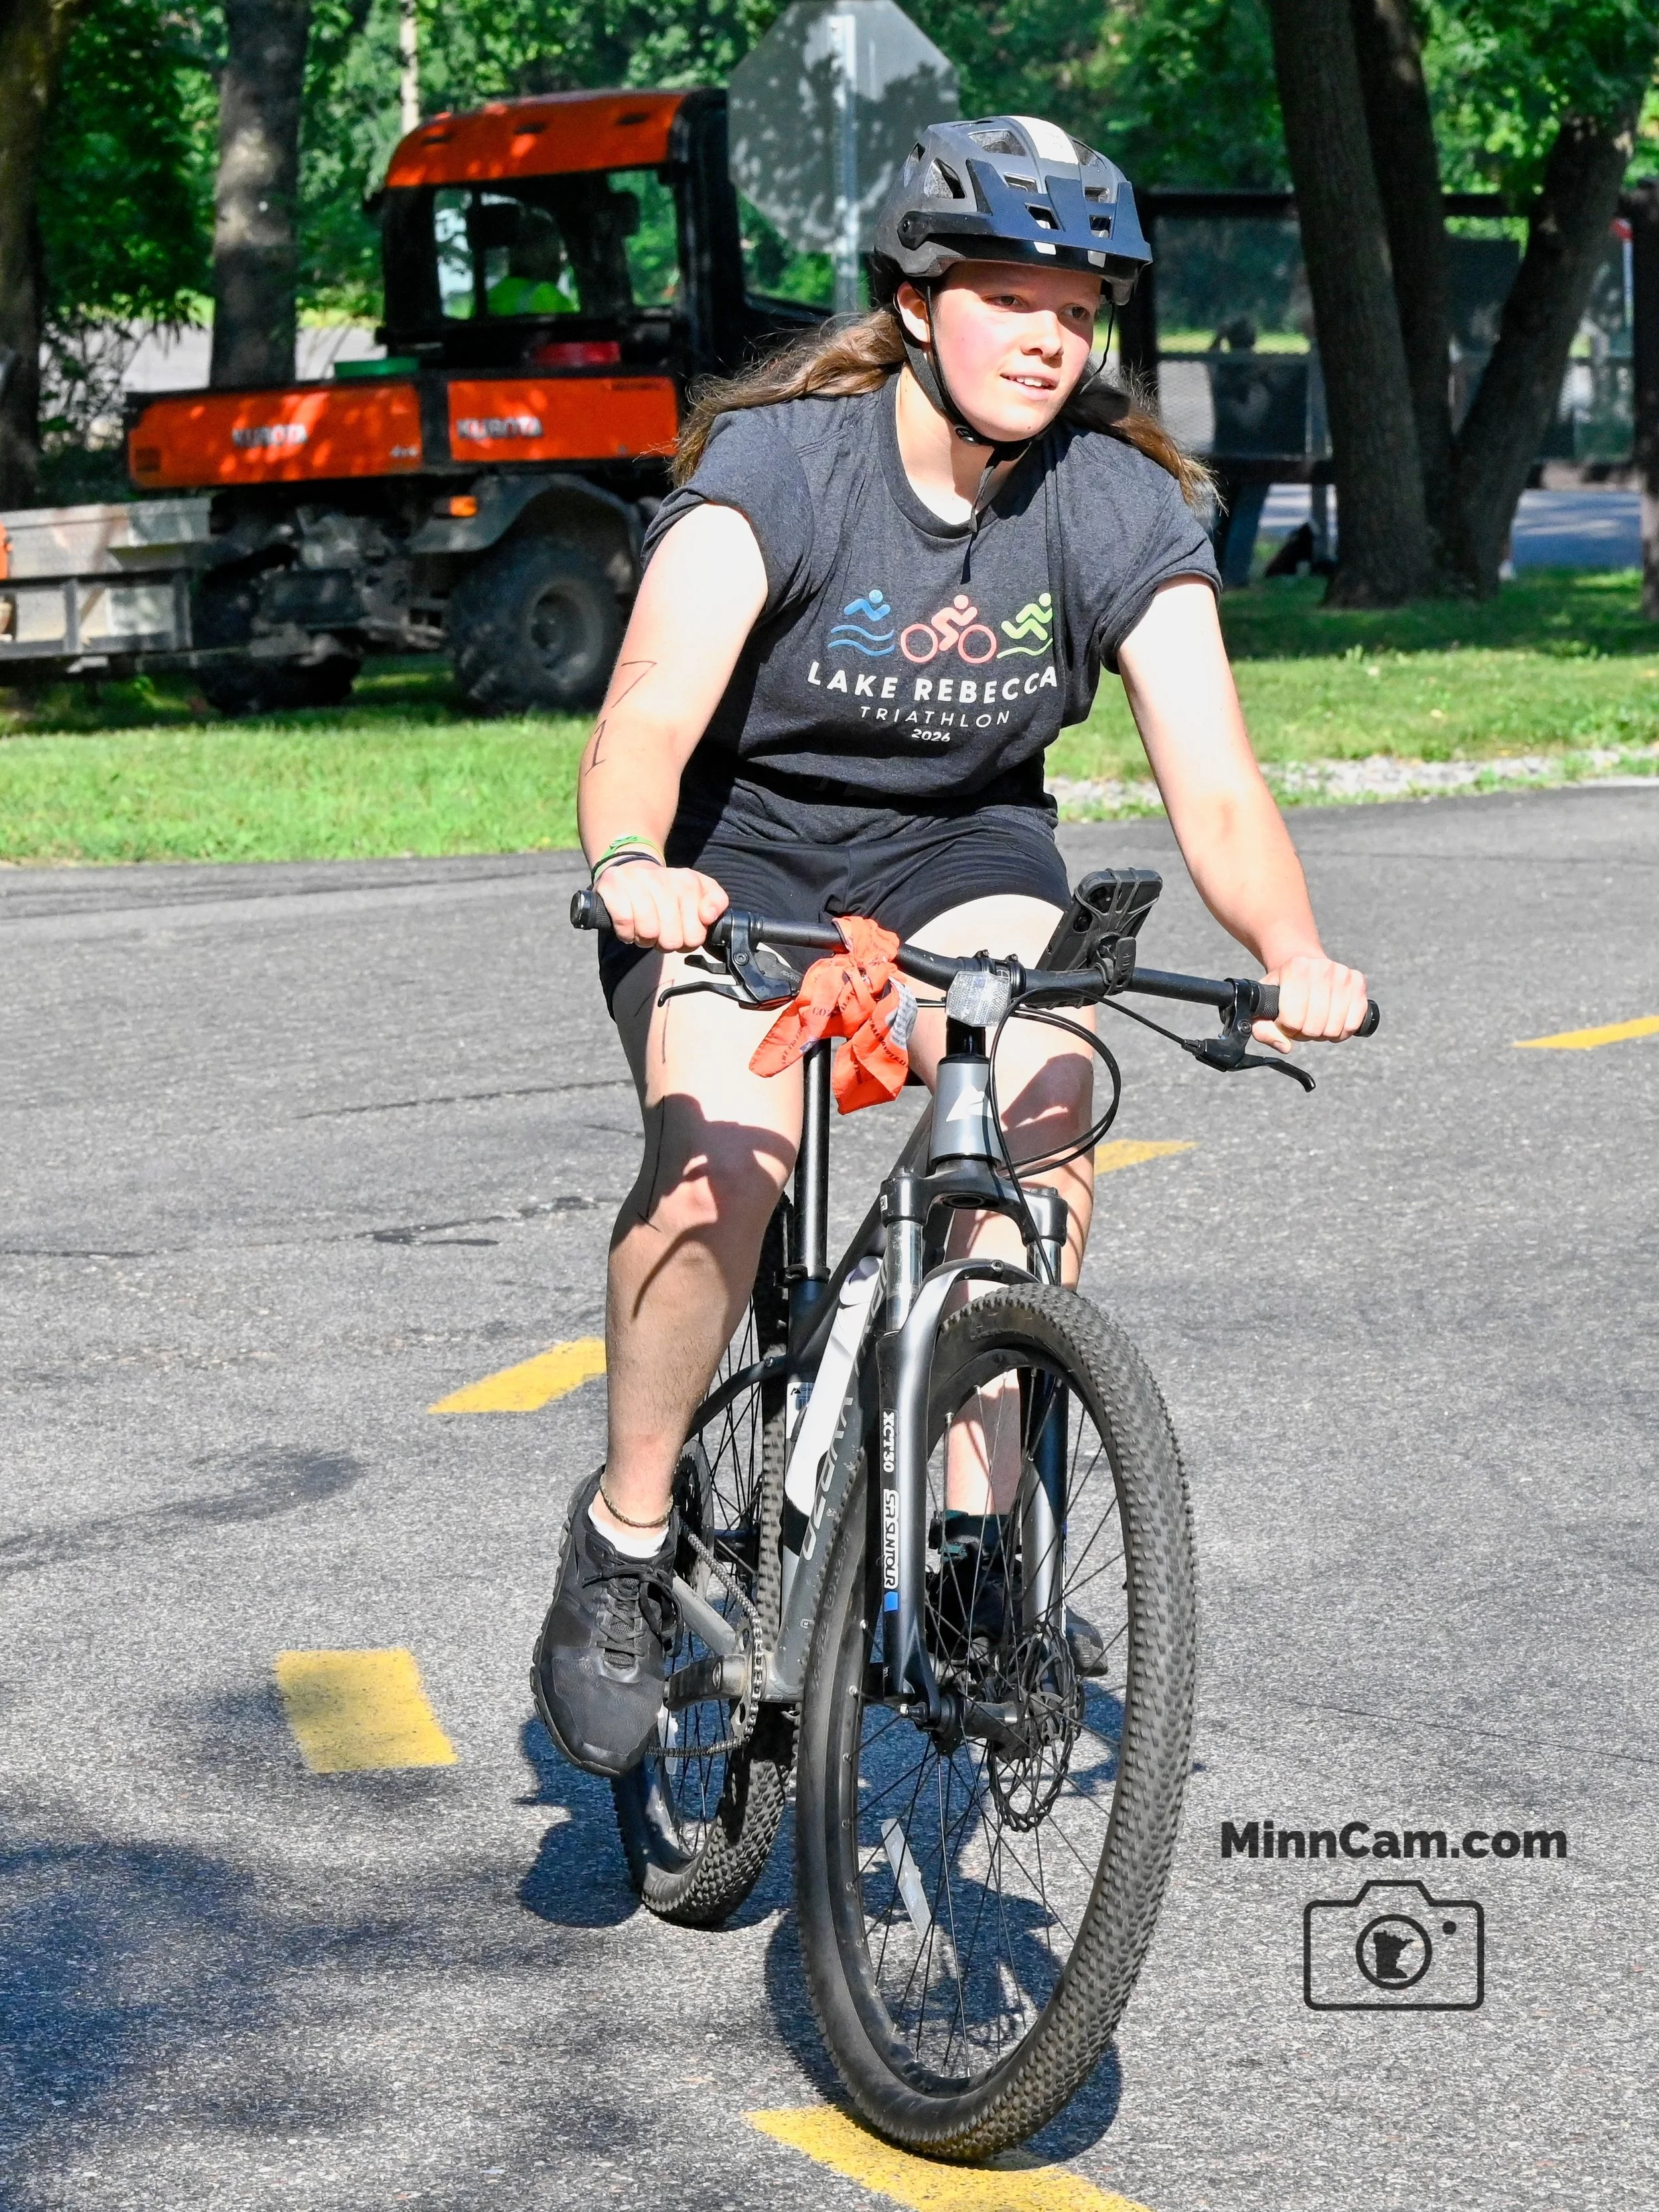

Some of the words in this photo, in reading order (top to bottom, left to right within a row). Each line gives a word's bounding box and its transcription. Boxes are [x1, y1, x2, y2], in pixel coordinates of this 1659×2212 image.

[807, 661, 899, 699] LAKE
[914, 666, 1058, 704] REBECCA
[861, 706, 1011, 728] TRIATHLON
[911, 728, 951, 743] 2026
[883, 1411, 895, 1473] XCT30
[884, 1489, 898, 1519] SR
[884, 1521, 898, 1588] SUNTOUR
